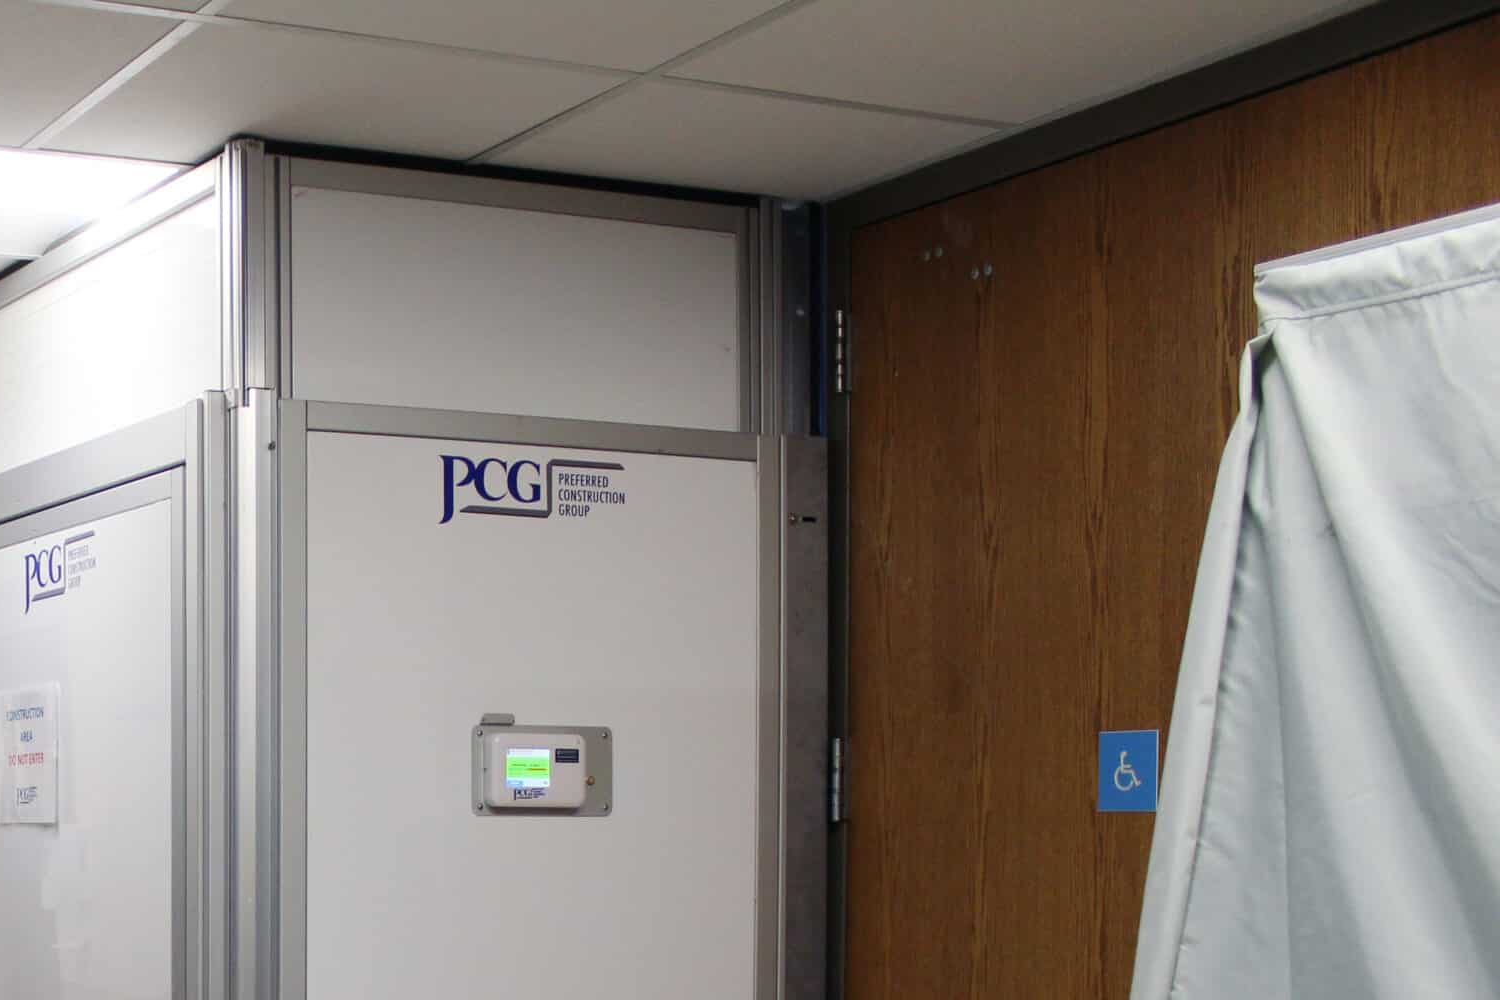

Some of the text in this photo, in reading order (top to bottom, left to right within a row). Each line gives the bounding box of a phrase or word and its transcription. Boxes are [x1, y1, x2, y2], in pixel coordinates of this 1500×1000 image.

[558, 473, 609, 489] PREFERRED
[438, 454, 542, 525] PCG
[558, 489, 626, 505] CONSTRUCTION
[558, 503, 590, 518] GROUP
[24, 544, 62, 615] PCG
[6, 706, 44, 722] CONSTRUCTION
[20, 729, 33, 743] AREA
[8, 752, 44, 767] DO NOT ENTER
